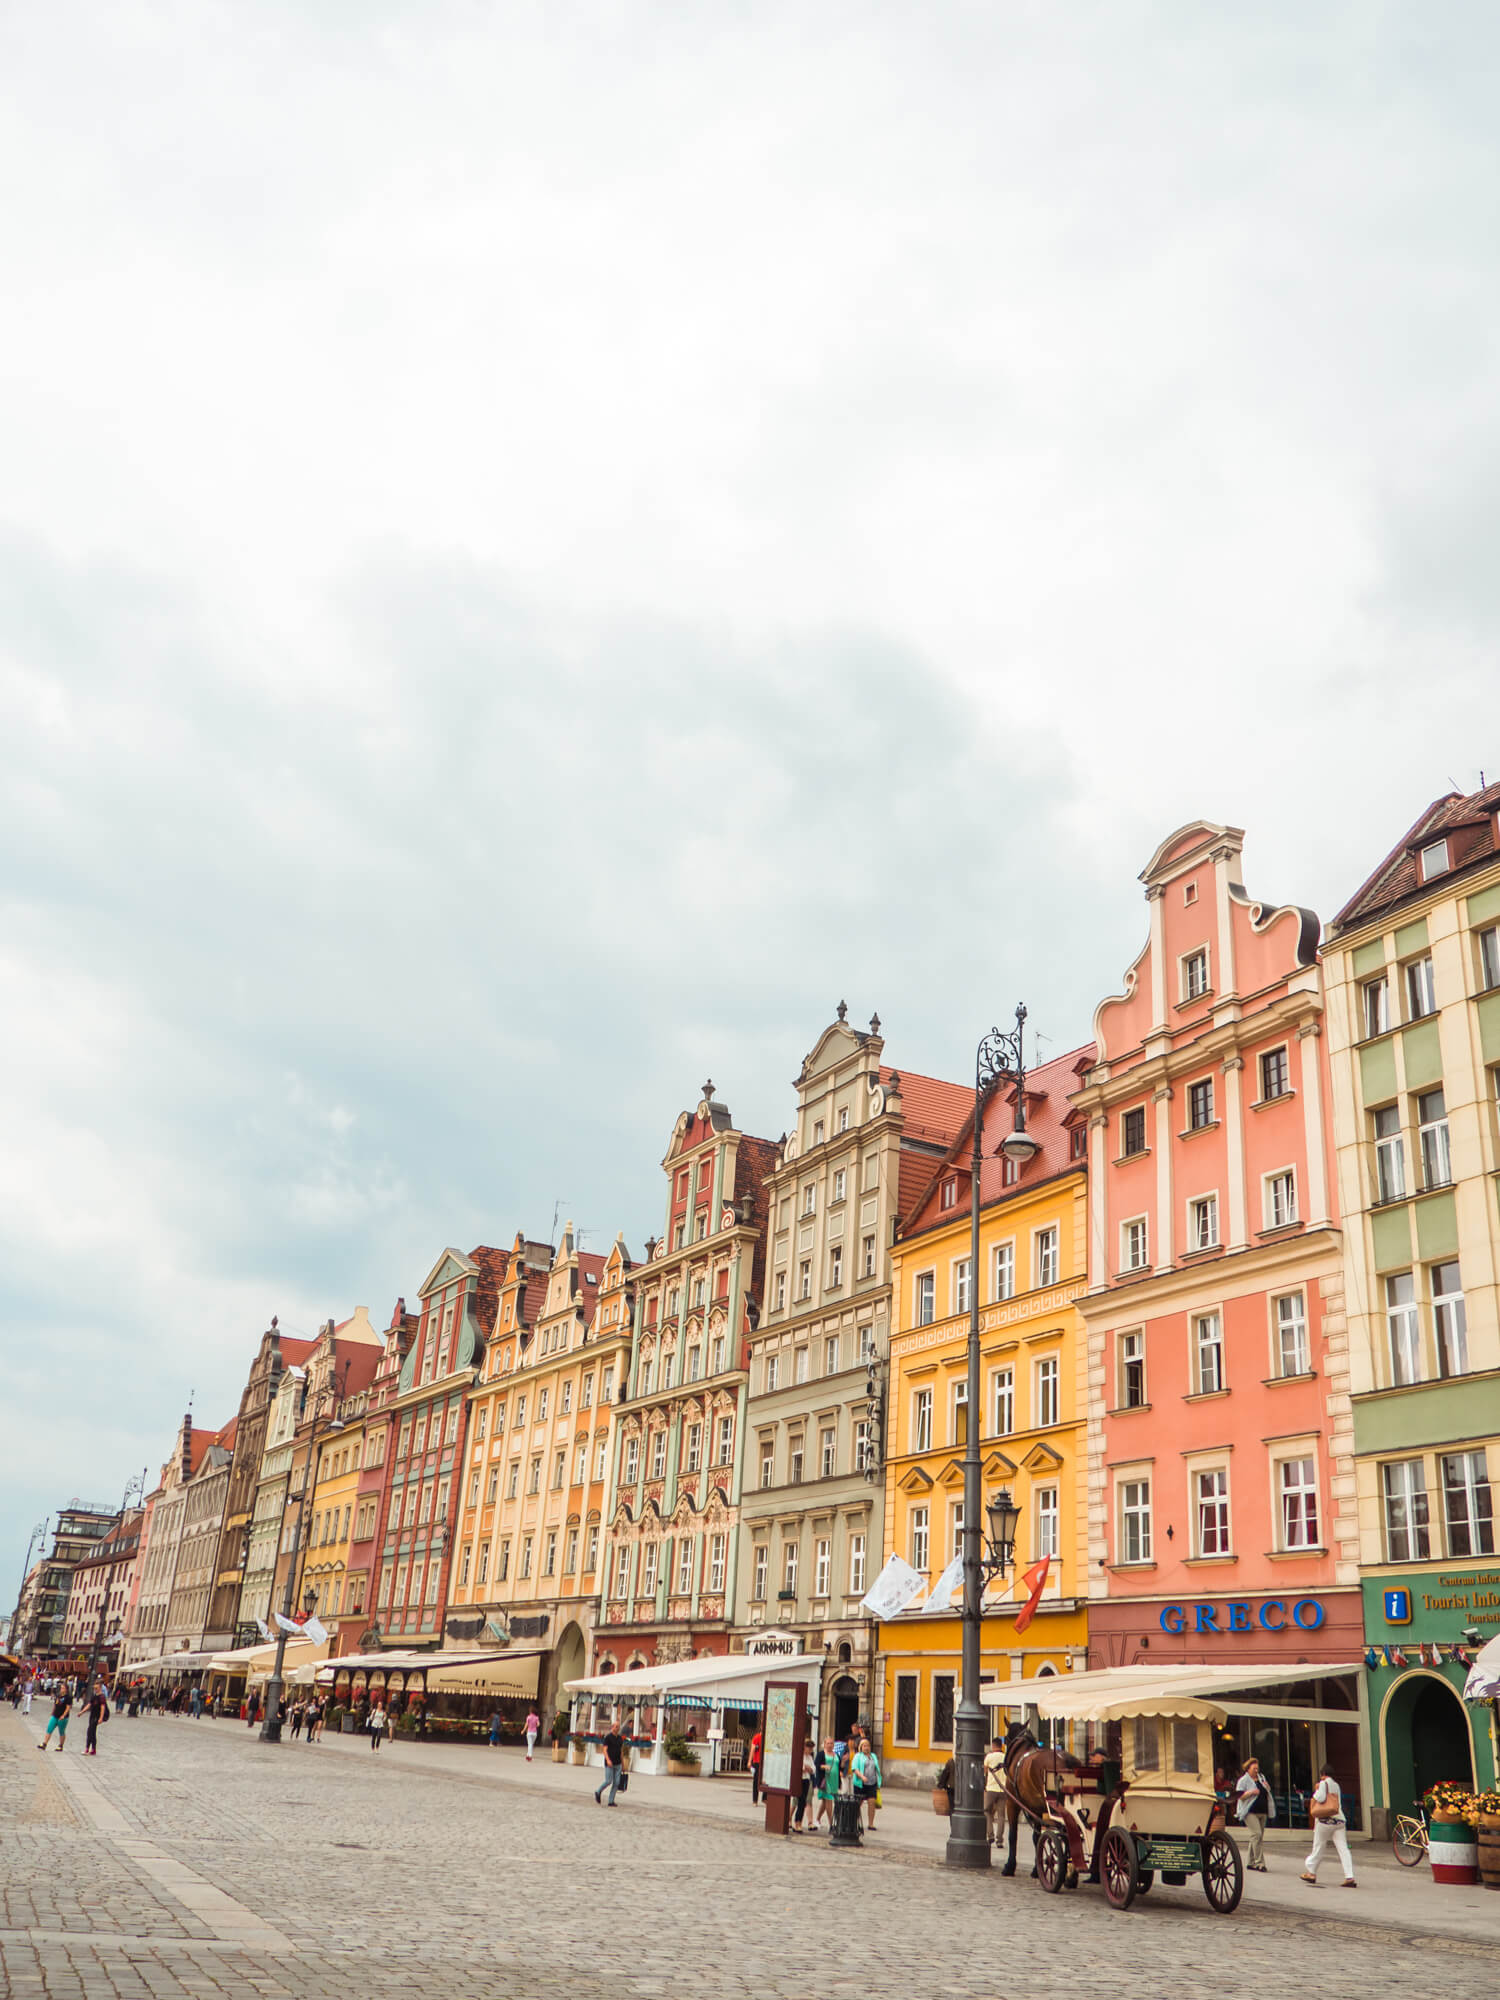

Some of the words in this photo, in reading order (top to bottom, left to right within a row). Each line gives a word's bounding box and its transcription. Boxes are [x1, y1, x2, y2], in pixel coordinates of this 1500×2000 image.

[1438, 1575, 1475, 1587] Centrum
[1422, 1592, 1469, 1609] Tourist
[1159, 1599, 1325, 1634] GRECO
[753, 1640, 793, 1655] AKROPOLIS
